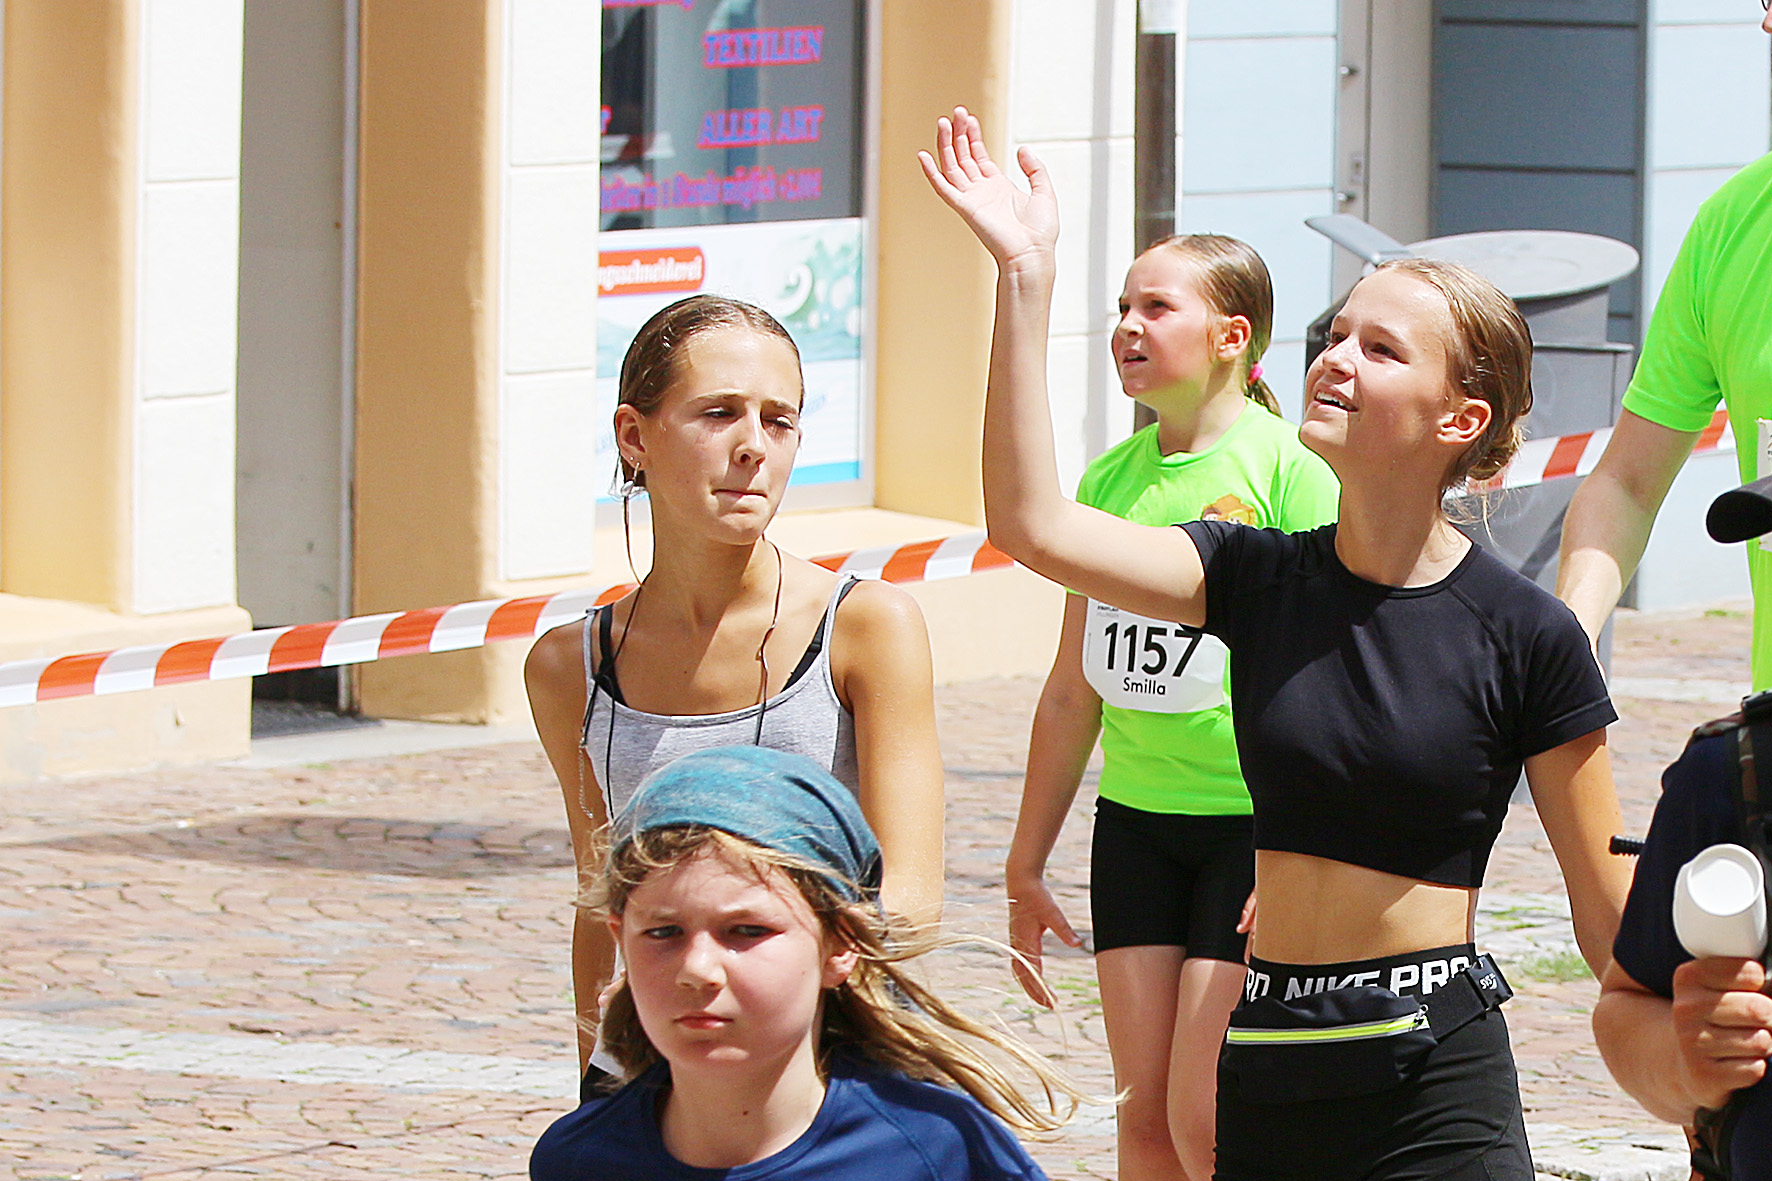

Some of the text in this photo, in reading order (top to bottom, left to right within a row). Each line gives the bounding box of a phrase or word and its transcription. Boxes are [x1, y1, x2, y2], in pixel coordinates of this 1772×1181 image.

[703, 27, 825, 68] TEXTILIEN
[698, 105, 824, 149] ALLER ART
[1105, 622, 1203, 677] 1157
[1123, 677, 1166, 696] Smilla
